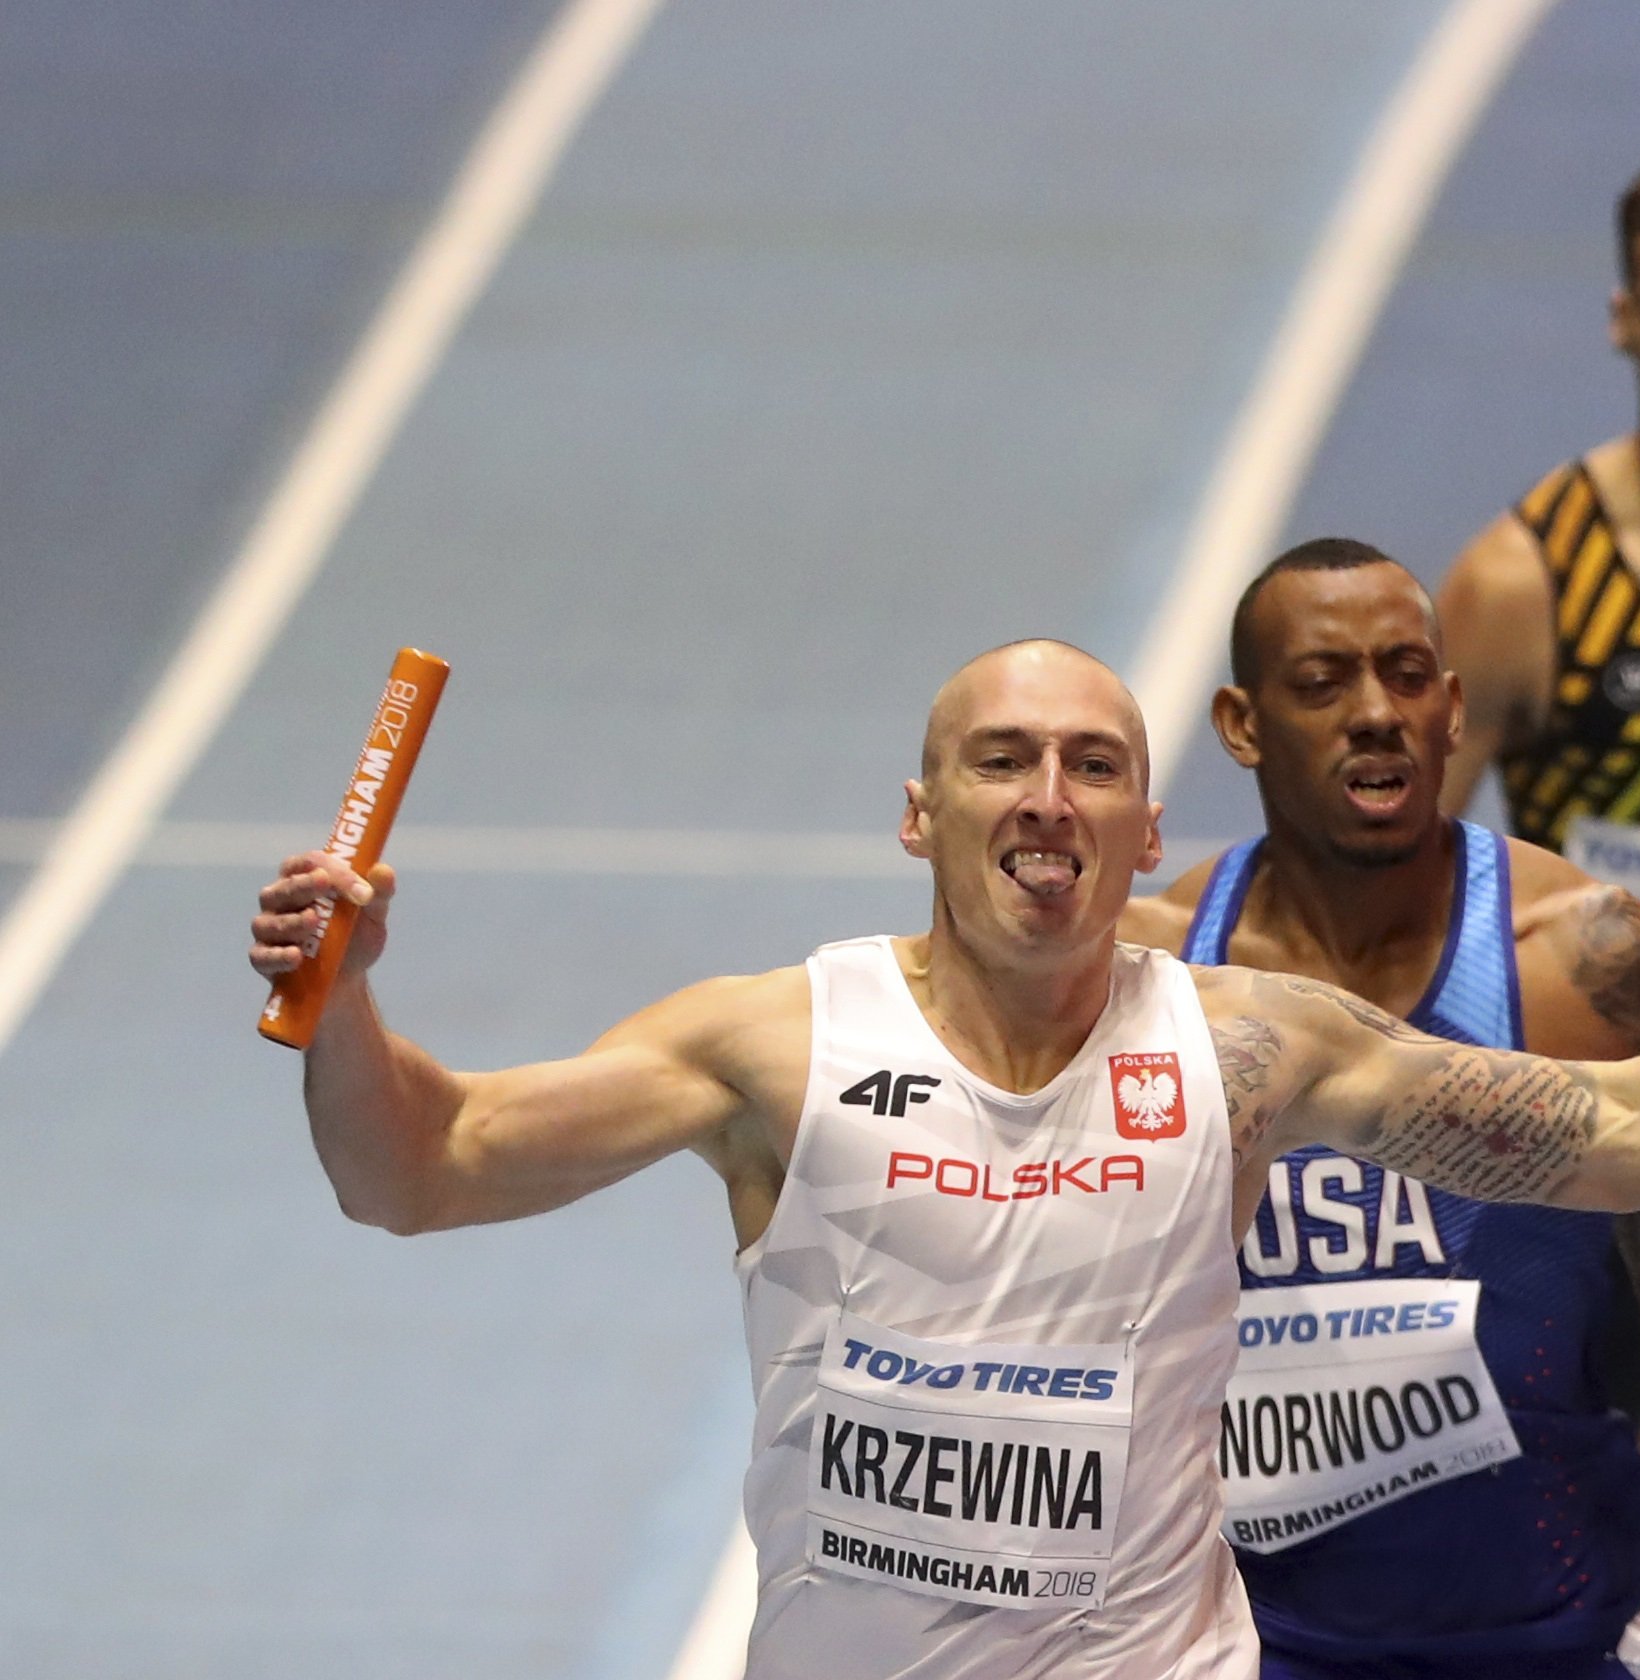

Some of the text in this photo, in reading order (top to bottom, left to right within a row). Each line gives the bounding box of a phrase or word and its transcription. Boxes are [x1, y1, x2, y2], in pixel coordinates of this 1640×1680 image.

[372, 679, 418, 749] 2018
[839, 1069, 942, 1117] 4F
[1114, 1055, 1174, 1068] POLSKA
[886, 1151, 1144, 1202] POLSKA
[1242, 1157, 1445, 1277] USA
[1238, 1301, 1458, 1348] OYO TIRES
[844, 1339, 1118, 1401] TOYO TIRES
[1220, 1375, 1481, 1479] NORWOOD
[821, 1413, 1103, 1530] KRZEWINA
[1233, 1460, 1439, 1545] BIRMINGHAM
[821, 1529, 1096, 1598] BIRMINGHAM 2018
